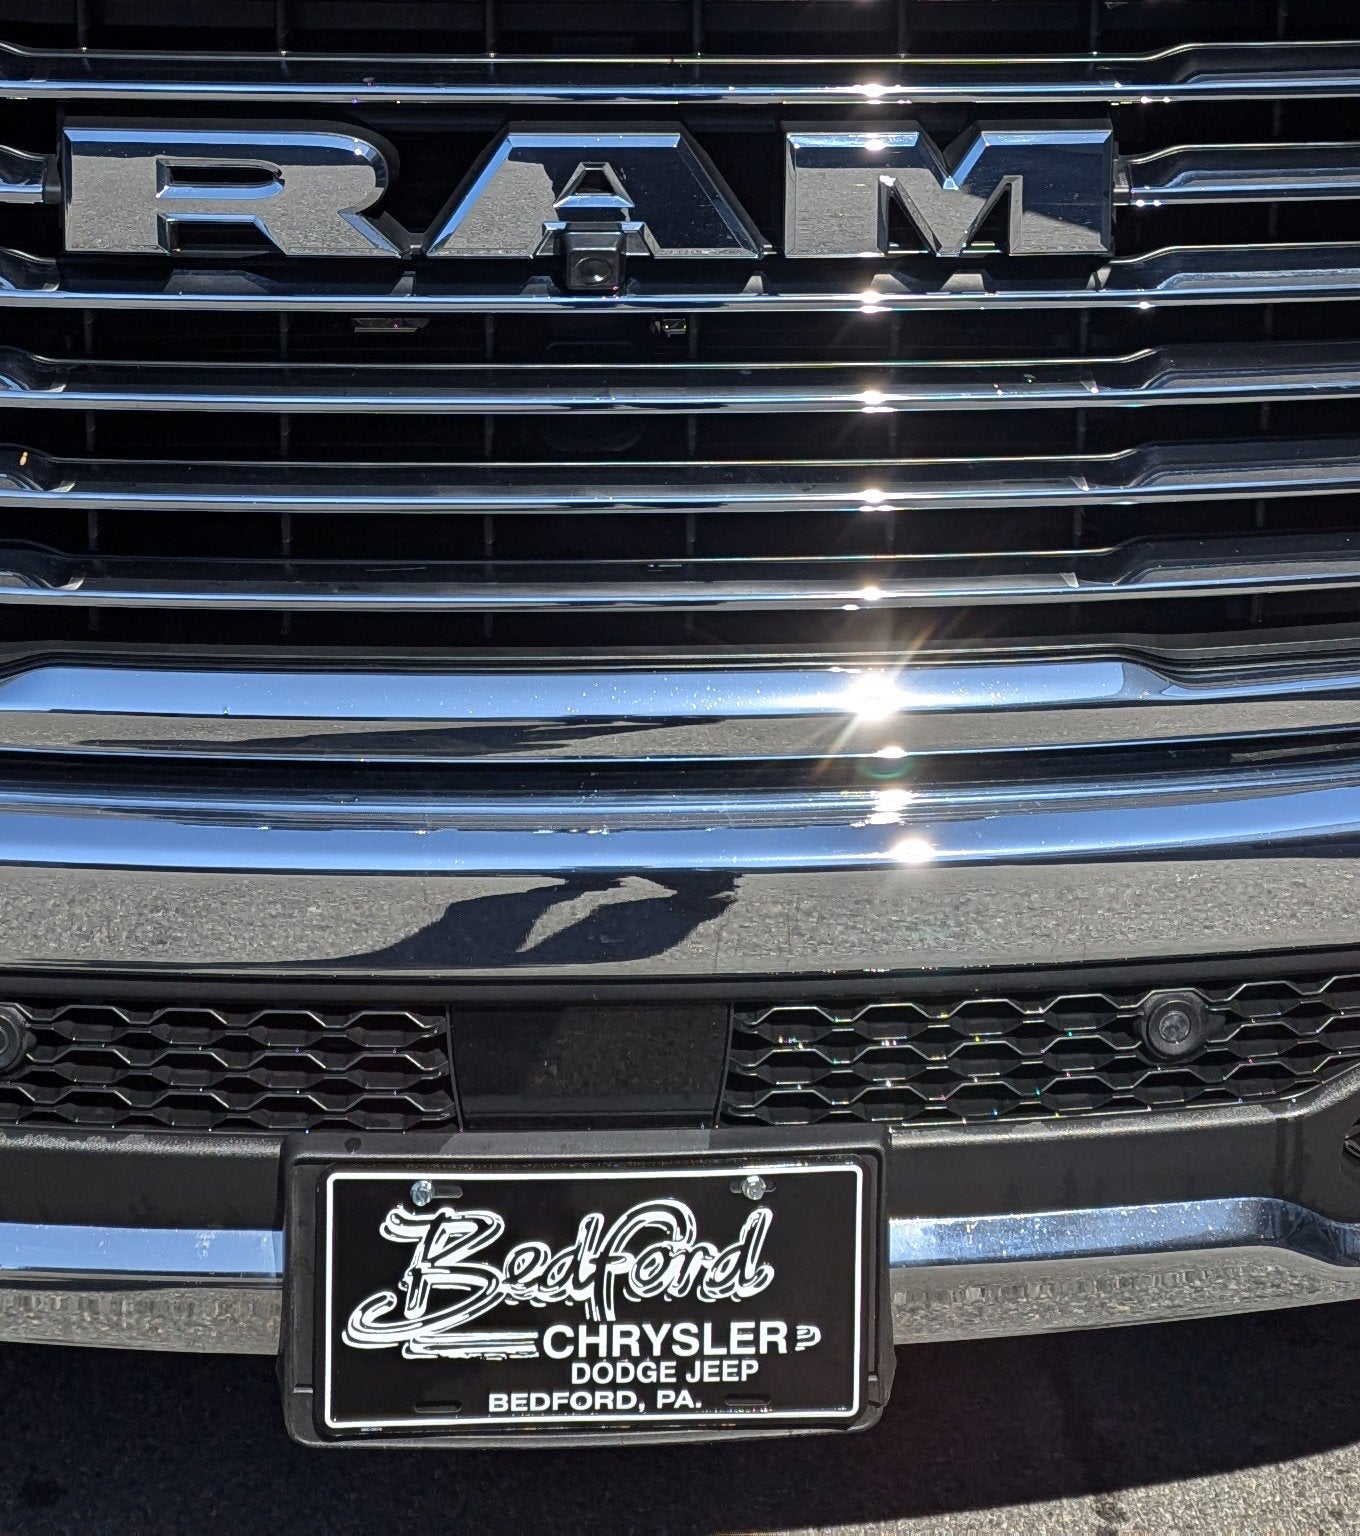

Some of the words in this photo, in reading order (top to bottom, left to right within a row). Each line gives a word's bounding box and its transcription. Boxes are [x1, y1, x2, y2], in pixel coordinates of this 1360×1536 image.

[61, 120, 1114, 259] RAM
[542, 1320, 789, 1360] CHRYSLER
[571, 1361, 680, 1386] DODGE
[685, 1359, 759, 1384] JEEP
[488, 1391, 646, 1414] BEDFORD,
[656, 1389, 703, 1410] PA.
